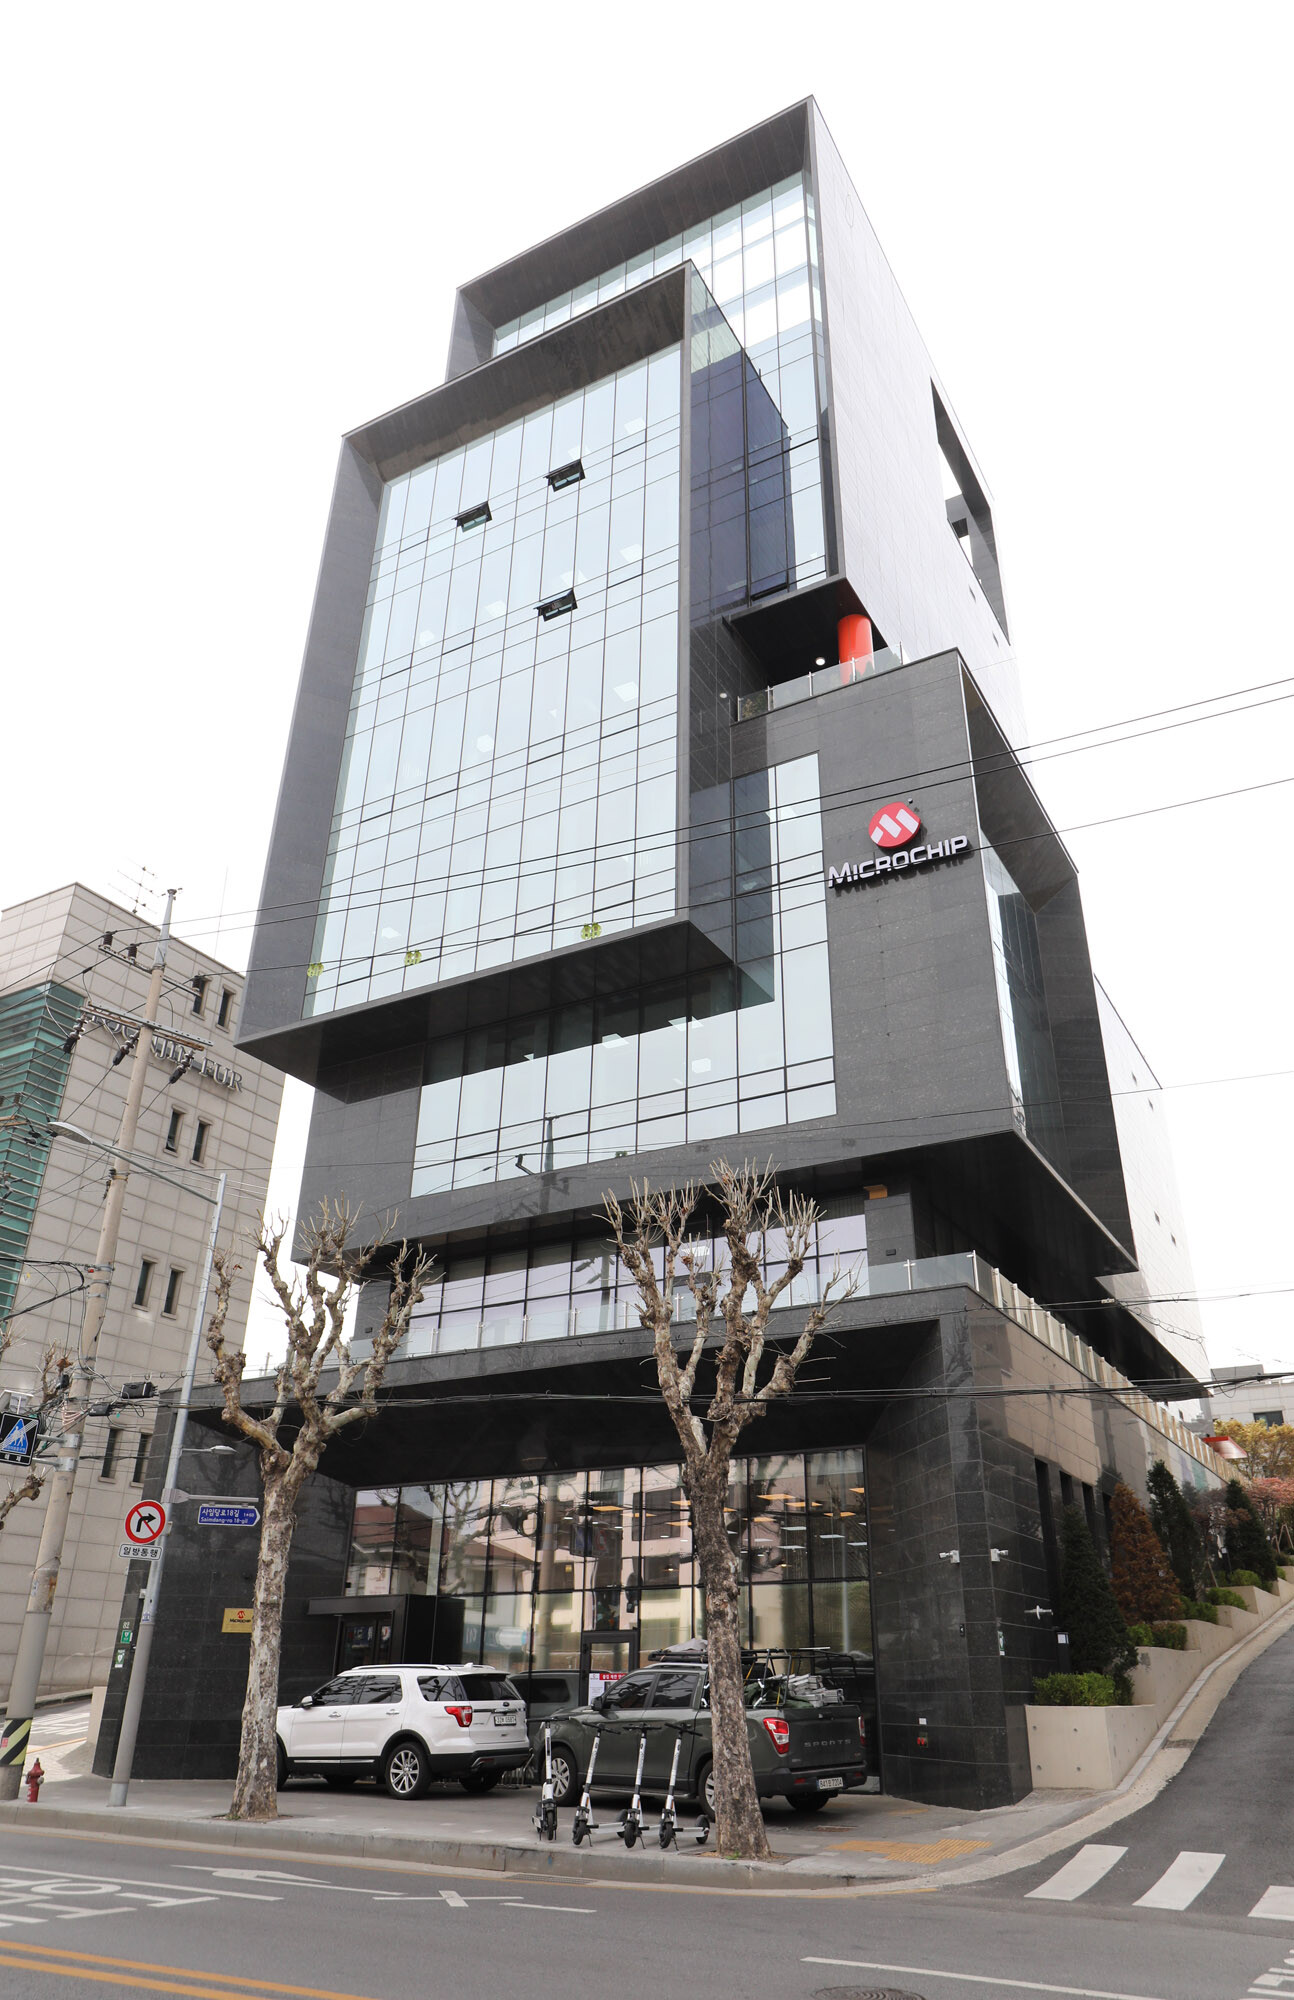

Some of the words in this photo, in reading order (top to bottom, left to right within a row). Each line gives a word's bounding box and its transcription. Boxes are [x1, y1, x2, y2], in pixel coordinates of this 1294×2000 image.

[828, 835, 968, 888] MICROCHIP
[199, 1056, 243, 1093] FUR
[202, 1508, 240, 1518] 사임당로18길
[123, 1546, 159, 1558] 일방통행
[804, 1738, 851, 1748] SPORTS
